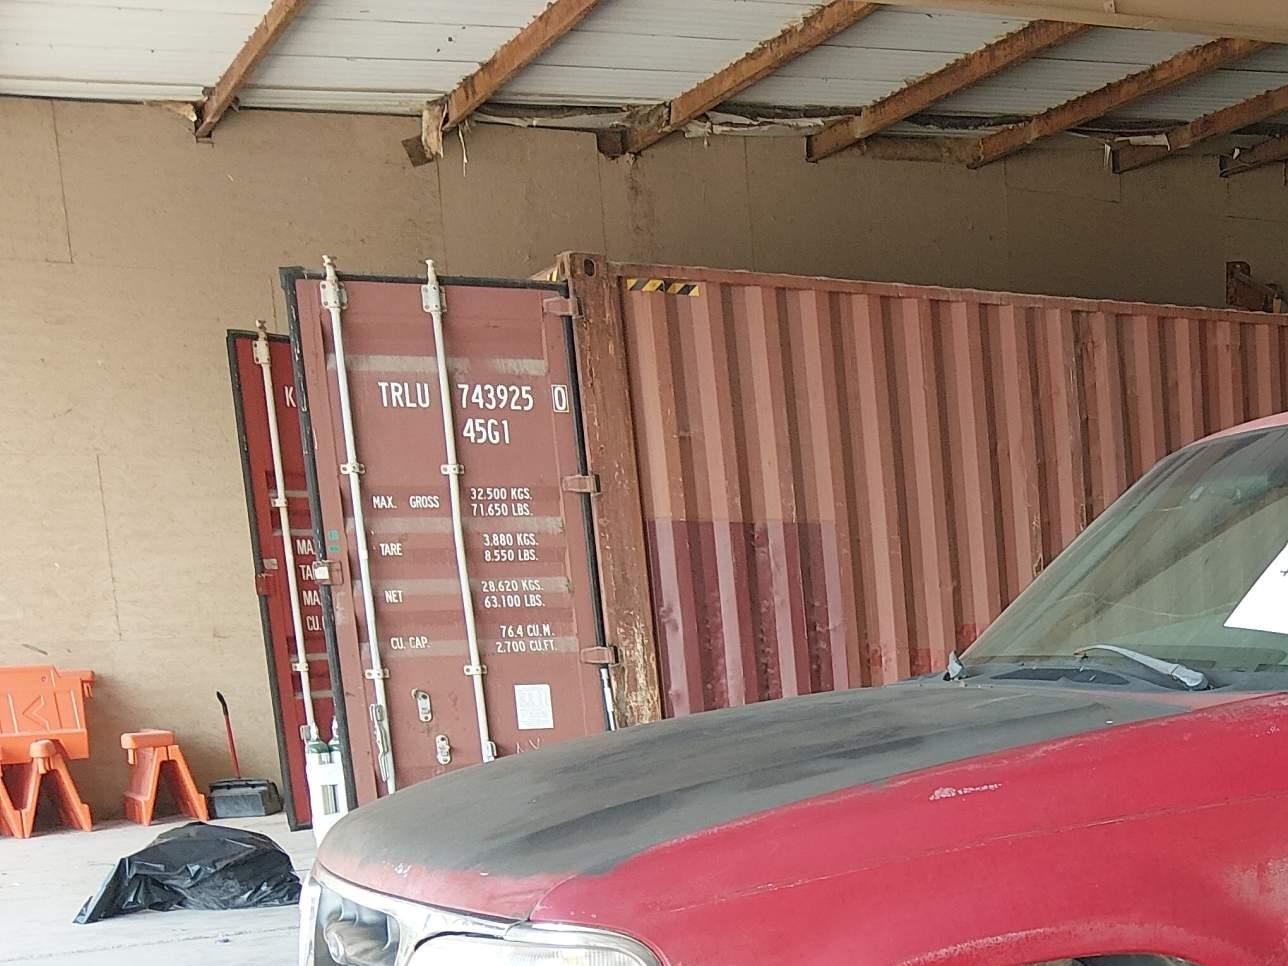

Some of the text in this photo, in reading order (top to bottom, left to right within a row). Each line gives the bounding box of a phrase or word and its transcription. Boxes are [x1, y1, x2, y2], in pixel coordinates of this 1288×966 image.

[378, 381, 430, 408] TRLU
[457, 383, 533, 411] 743925
[463, 418, 511, 444] 45G1
[470, 487, 533, 500] 32.500 KGS.
[372, 495, 440, 509] MAX. GROSS
[471, 503, 534, 517] 71.650 LBS.
[516, 533, 539, 546] KGS.
[379, 543, 403, 556] TARE
[484, 549, 539, 562] 8.550 LBS.
[481, 579, 544, 593] 28.620 KGS.
[302, 590, 323, 606] MA
[384, 590, 403, 603] NET
[484, 594, 546, 609] 63.100 LBS.
[500, 625, 524, 638] 76.4
[390, 637, 406, 650] CU.
[495, 640, 526, 653] 2.700
